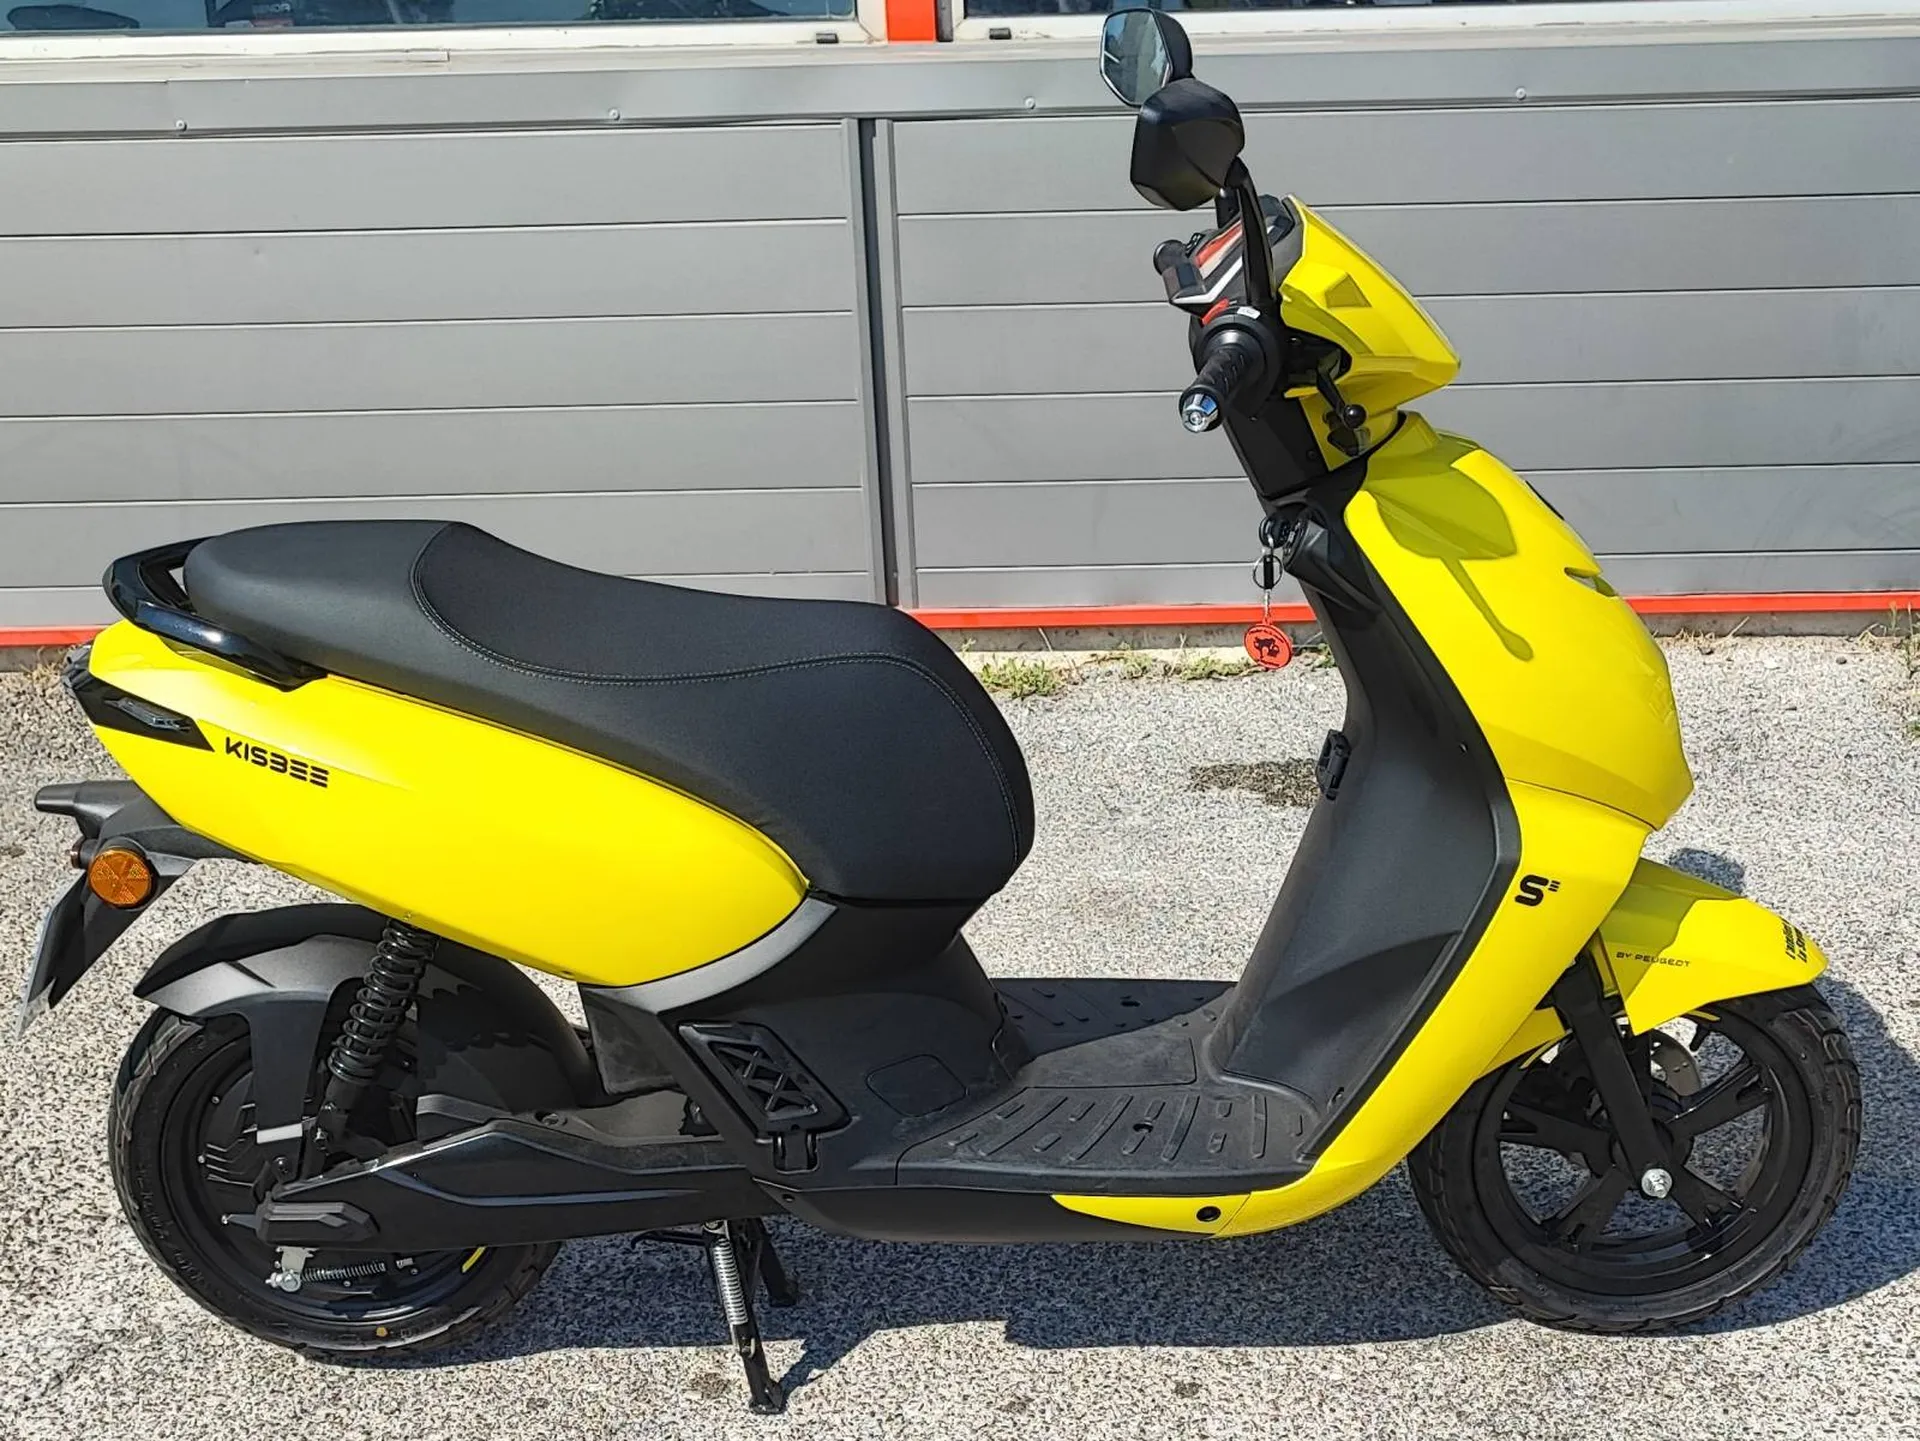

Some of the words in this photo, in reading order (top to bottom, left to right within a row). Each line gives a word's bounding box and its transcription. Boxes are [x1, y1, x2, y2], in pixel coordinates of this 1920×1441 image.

[225, 736, 329, 788] KISBEE
[1616, 951, 1632, 959] BY
[1635, 953, 1691, 967] PEUGEOT
